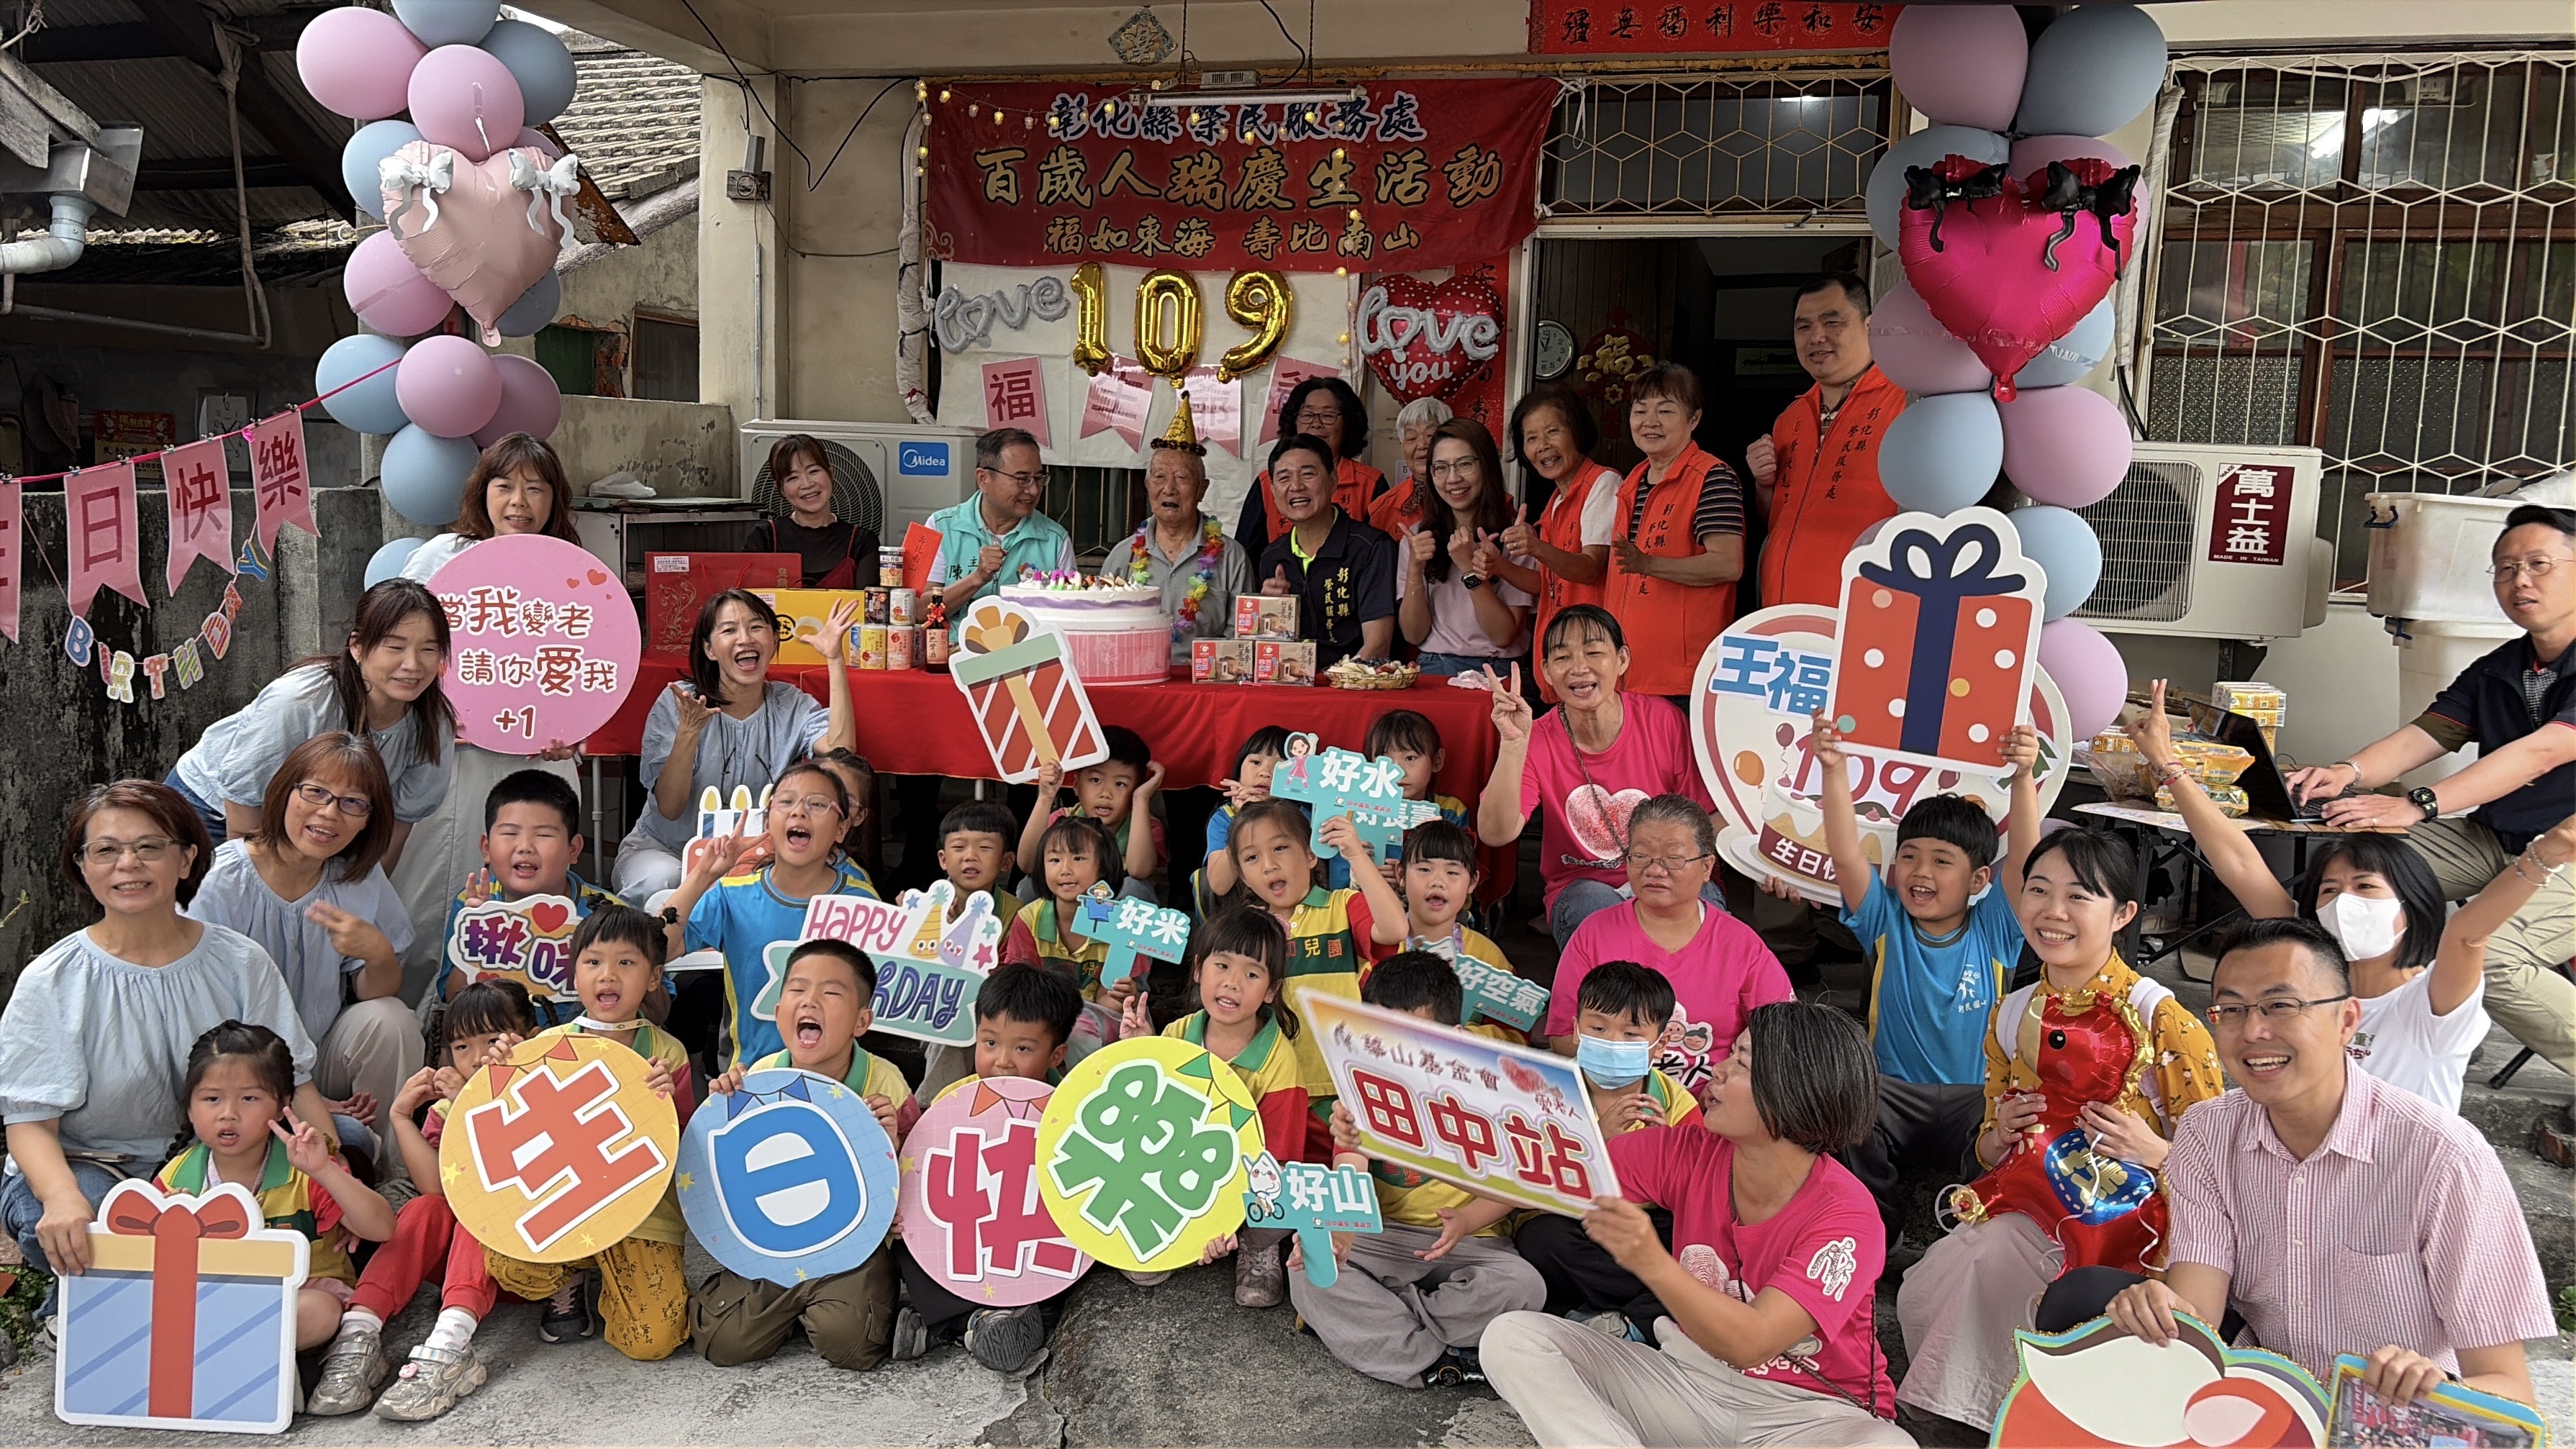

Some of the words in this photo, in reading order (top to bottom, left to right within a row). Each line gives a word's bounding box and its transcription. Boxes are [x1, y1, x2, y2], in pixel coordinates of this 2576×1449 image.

[1047, 93, 1427, 143] 彰化縣榮民服務處
[975, 144, 1504, 212] 百歲人瑞慶生活動
[1045, 216, 1215, 259] 福如東海
[1242, 218, 1422, 259] 壽比南山
[1070, 261, 1293, 381] 109
[989, 369, 1036, 422] 福
[1389, 360, 1453, 391] you
[257, 432, 303, 512] 樂
[908, 454, 946, 468] Midea
[81, 486, 123, 573] 日
[175, 463, 222, 543] 快
[2226, 469, 2279, 554] 萬士益
[440, 586, 594, 639] 當我變老
[1336, 567, 1351, 617] 彰化縣
[460, 645, 618, 696] 請你愛我
[1712, 636, 1832, 712] 王福
[493, 705, 536, 740] +1
[1319, 750, 1400, 799] 好水
[1116, 899, 1187, 946] 好米
[466, 1059, 668, 1253] 生
[1048, 1058, 1240, 1263] 樂
[1351, 1068, 1593, 1201] 田中站
[709, 1101, 868, 1258] 日
[1287, 1168, 1373, 1215] 好山
